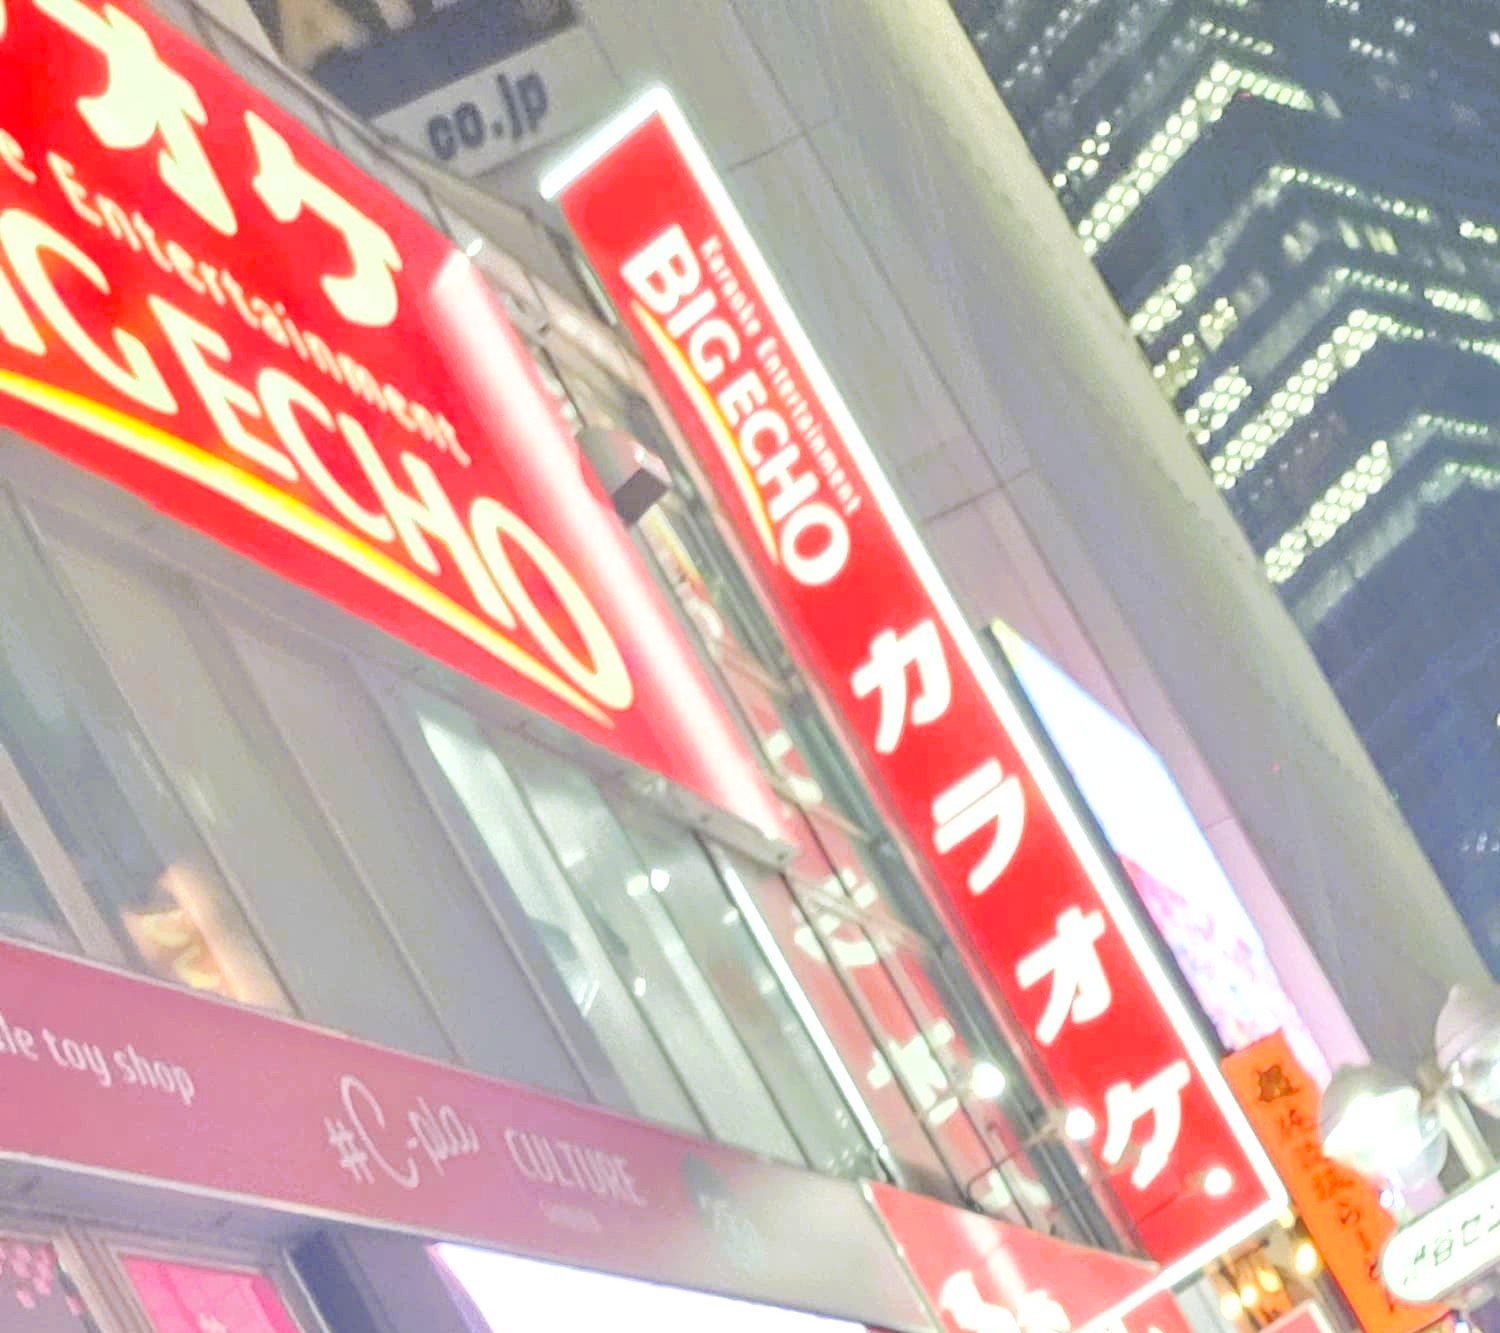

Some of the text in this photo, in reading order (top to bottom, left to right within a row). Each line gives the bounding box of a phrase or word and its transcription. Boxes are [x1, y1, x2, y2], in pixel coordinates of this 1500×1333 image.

[427, 70, 548, 161] co.jp
[46, 150, 471, 468] Entertainment
[619, 223, 851, 587] BIG ECHO
[146, 293, 634, 712] ECHO
[850, 616, 1192, 1191] カラオケ
[41, 1027, 112, 1088] toy
[113, 1044, 196, 1105] shop
[503, 1127, 648, 1207] CULTURE
